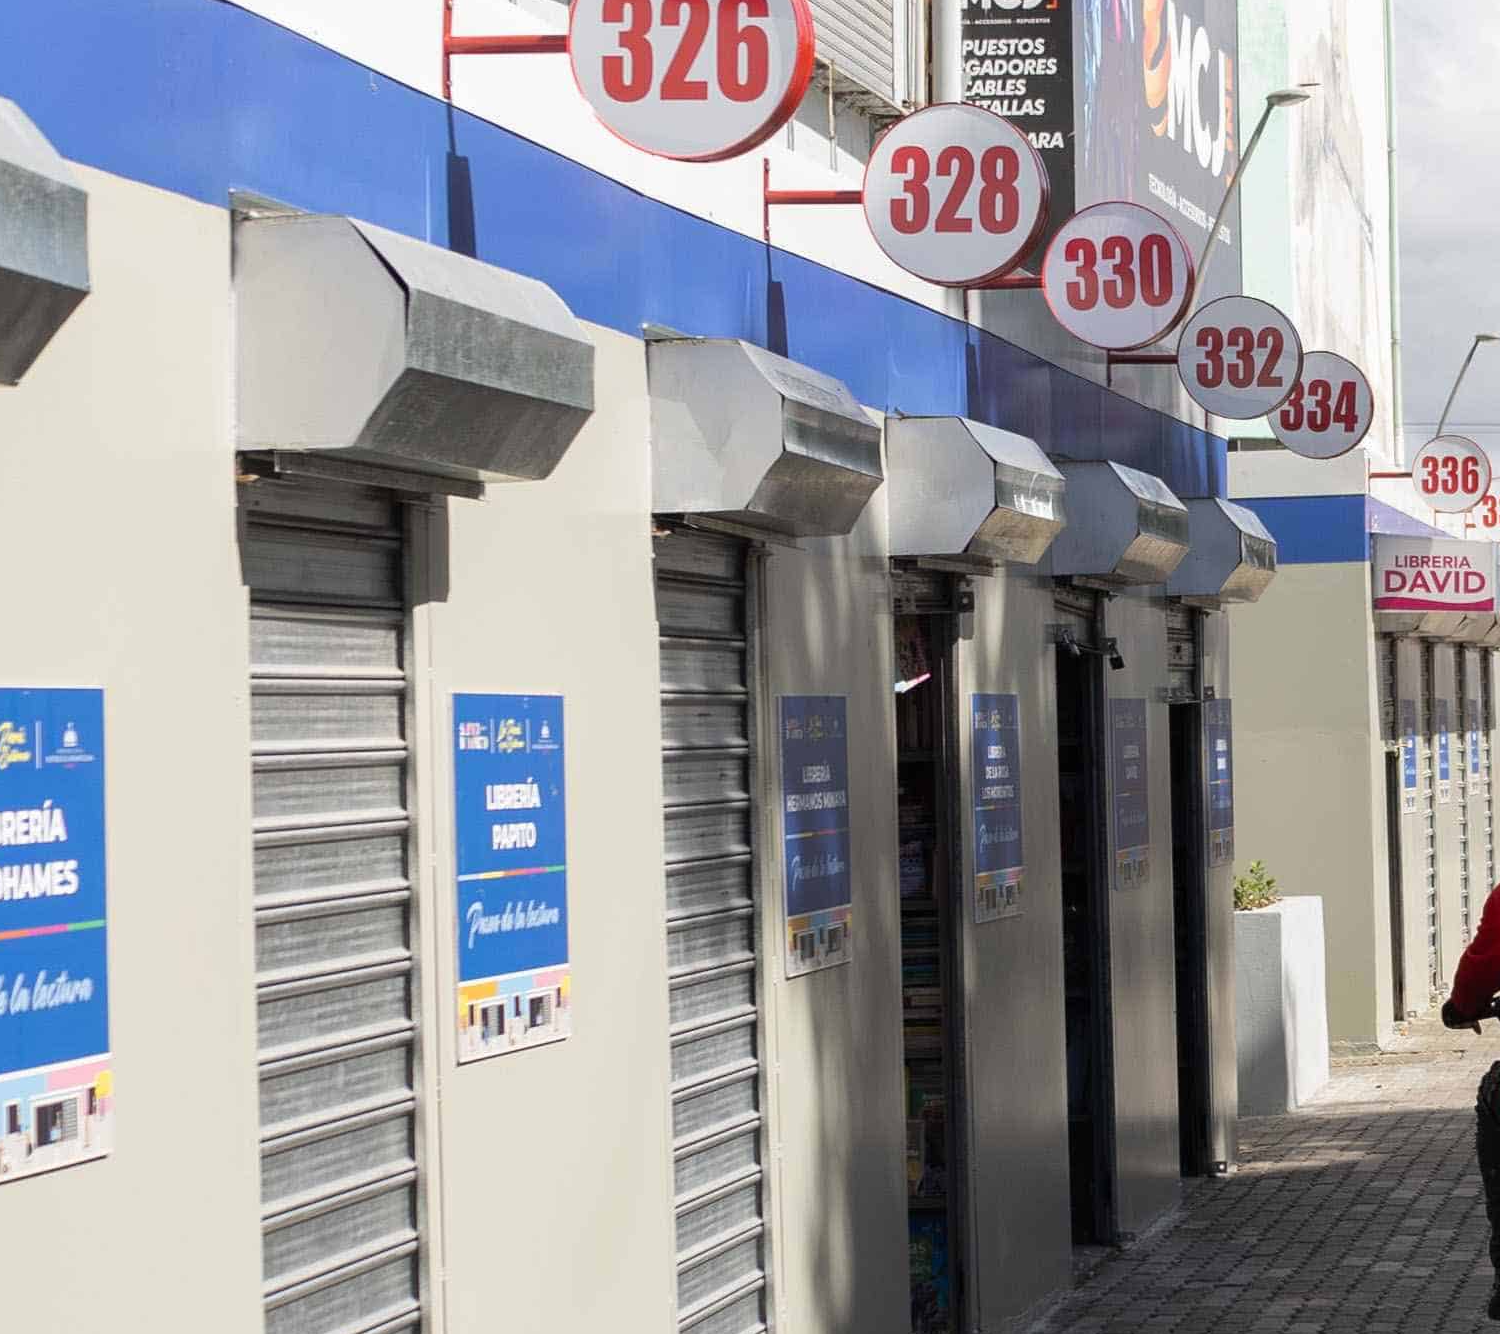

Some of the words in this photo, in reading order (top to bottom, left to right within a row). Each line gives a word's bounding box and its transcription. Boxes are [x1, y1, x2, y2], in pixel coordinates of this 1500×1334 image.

[889, 145, 1021, 234] 328
[1064, 234, 1172, 312] 330
[1196, 326, 1284, 390] 332
[1280, 380, 1359, 434] 334
[1421, 455, 1480, 495] 336
[1384, 570, 1486, 595] DAVID
[1395, 554, 1471, 570] LIBRERIA
[485, 777, 542, 812] LIBRERÍA
[492, 821, 538, 850] PAPITO
[10, 972, 32, 1015] la
[32, 969, 94, 1011] lectura
